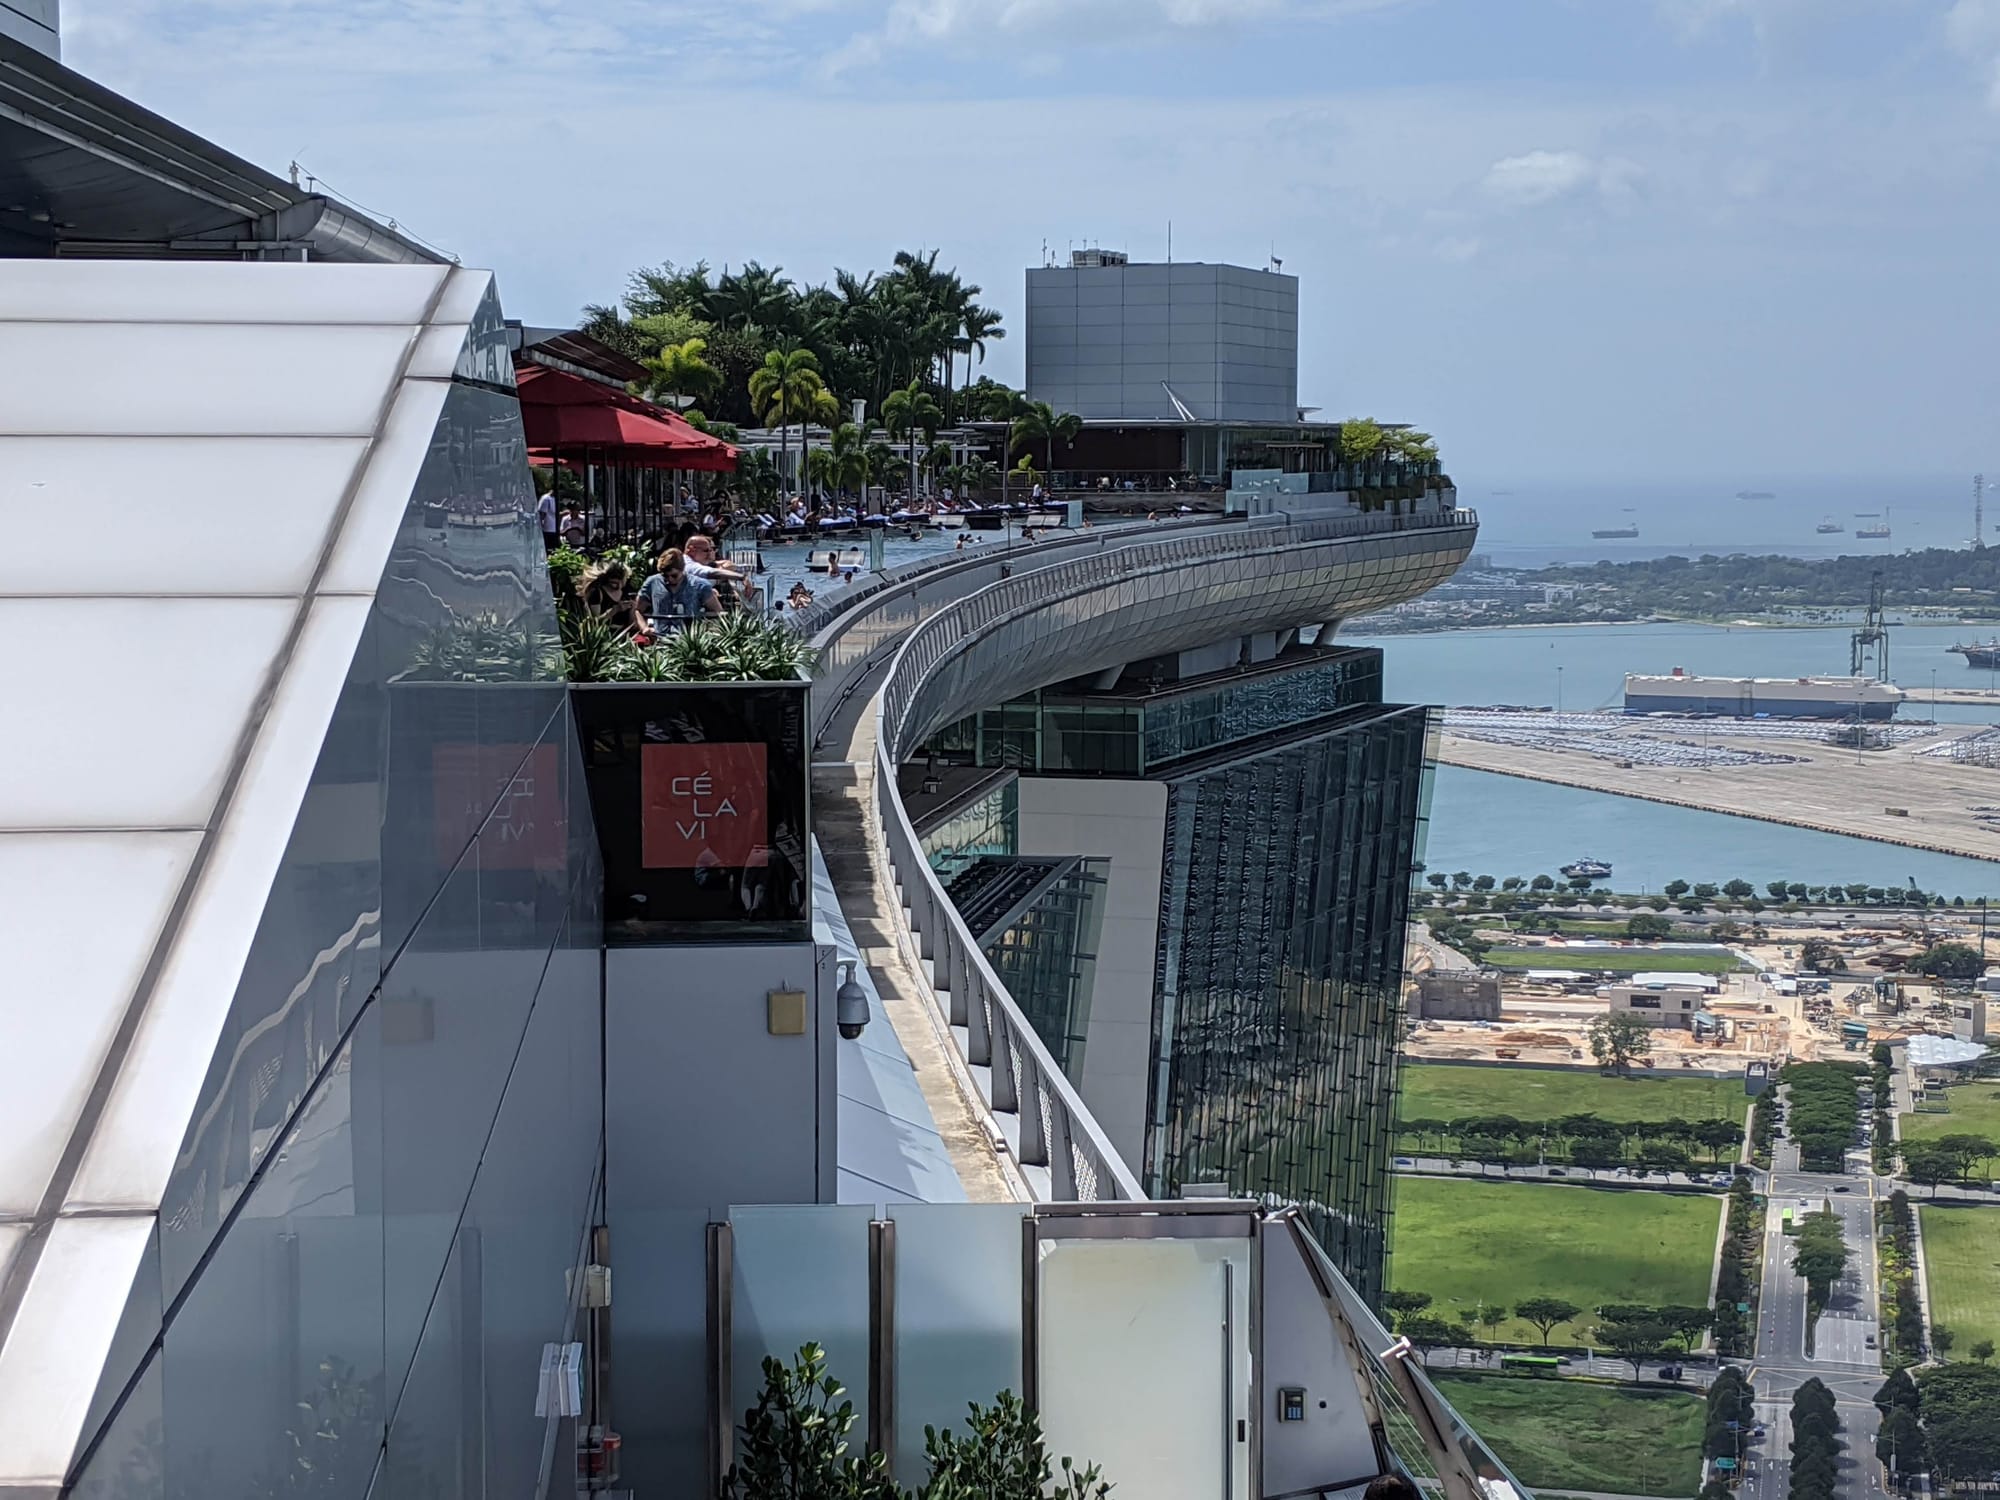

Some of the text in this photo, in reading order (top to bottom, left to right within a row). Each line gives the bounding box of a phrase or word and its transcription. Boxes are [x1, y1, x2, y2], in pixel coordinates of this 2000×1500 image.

[672, 770, 712, 795] CÉ
[693, 798, 738, 817] LA
[675, 820, 706, 840] VI
